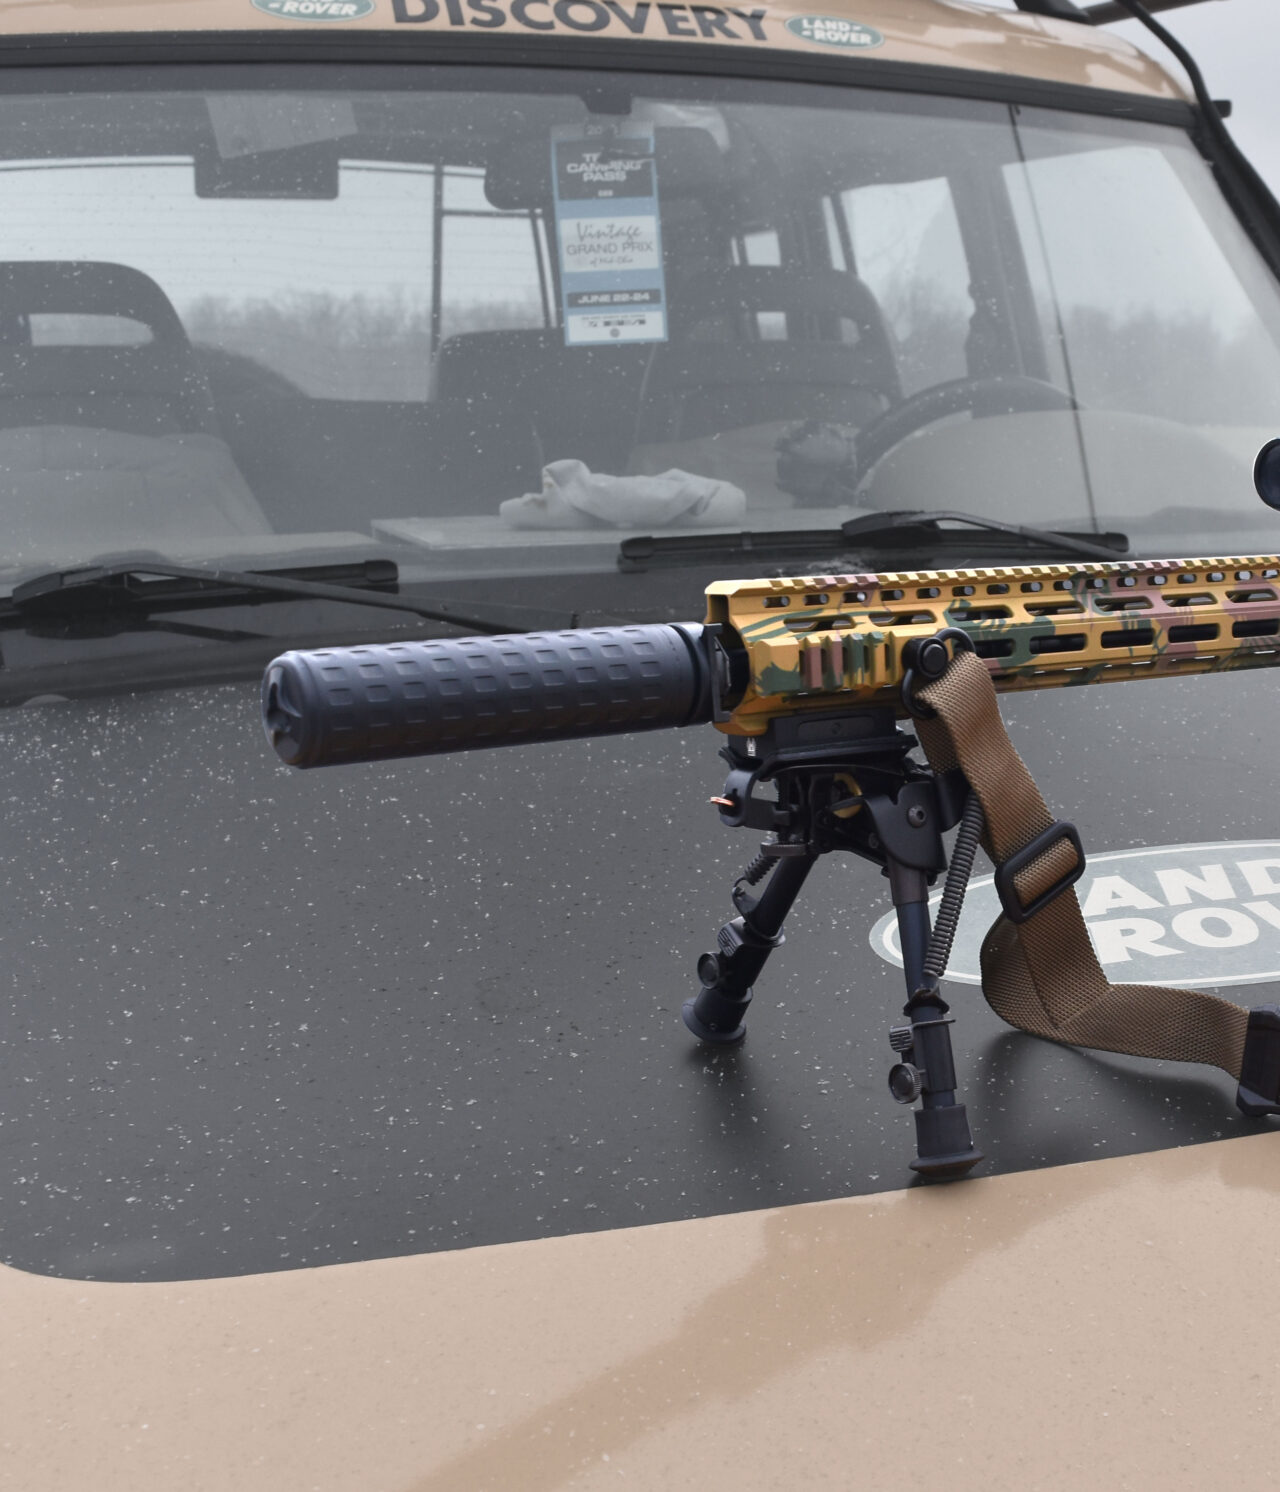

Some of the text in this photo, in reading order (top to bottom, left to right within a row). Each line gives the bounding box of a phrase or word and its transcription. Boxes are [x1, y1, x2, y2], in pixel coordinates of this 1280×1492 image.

[282, 1, 358, 16] ROVER
[391, 0, 767, 41] DISCOVERY
[802, 19, 851, 32] LAND
[814, 29, 872, 45] ROVER
[583, 171, 627, 182] PASS
[576, 222, 642, 245] Vintage
[566, 241, 654, 256] GRAND PRIX
[578, 294, 611, 304] JUNE
